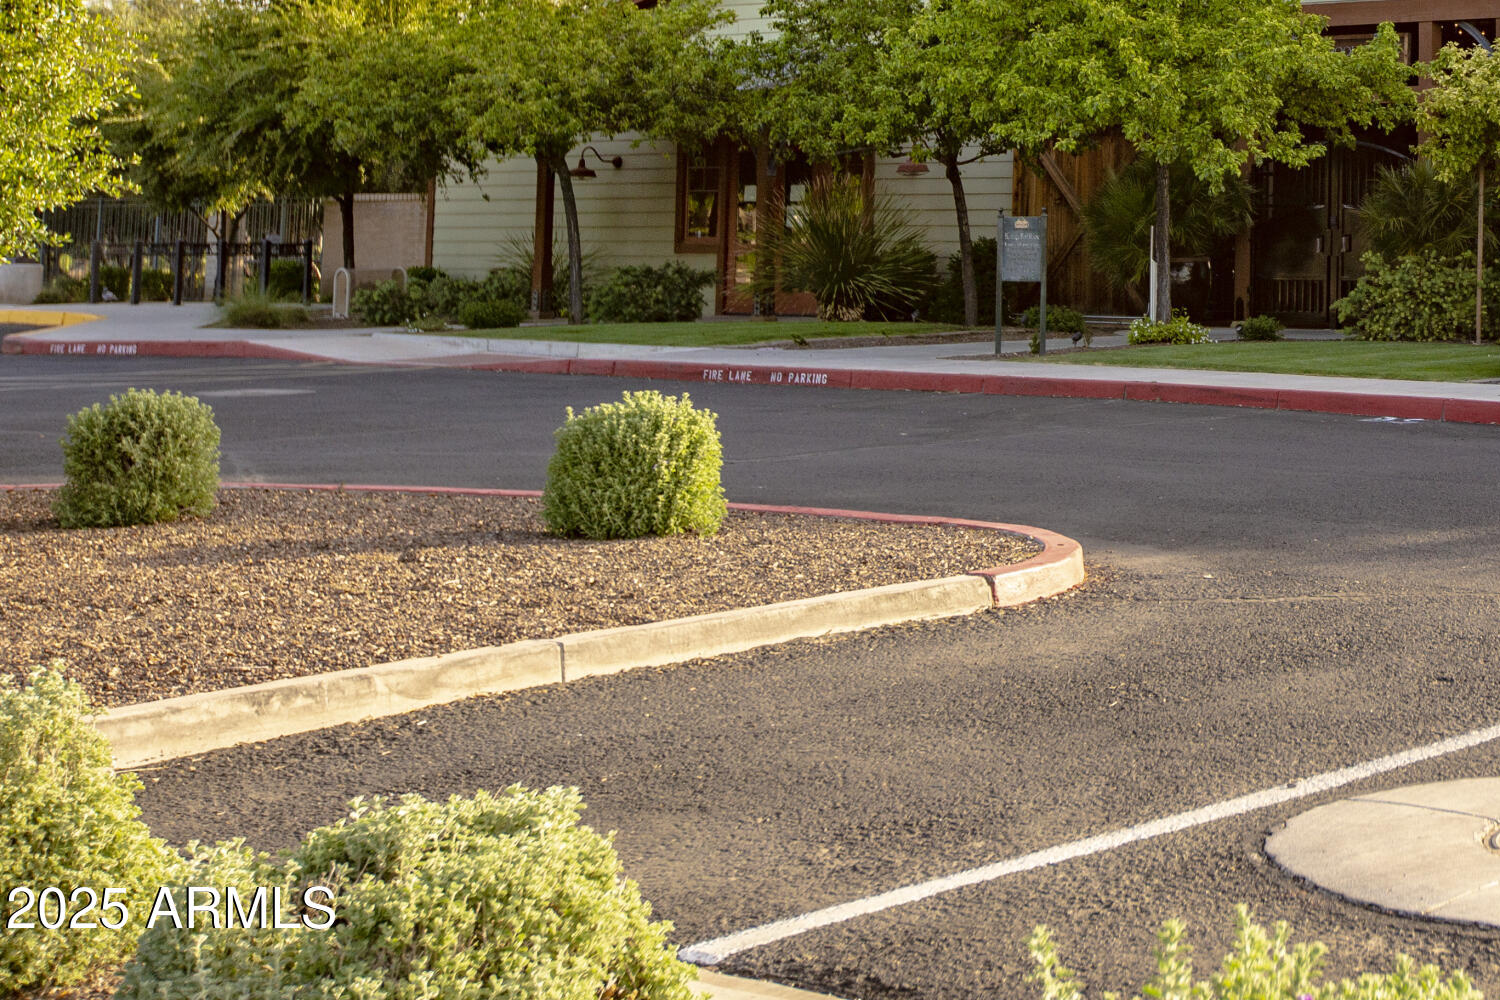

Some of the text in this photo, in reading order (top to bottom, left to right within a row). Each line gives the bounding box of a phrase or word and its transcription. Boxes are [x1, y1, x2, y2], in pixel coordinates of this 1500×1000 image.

[50, 344, 137, 355] FIRE LANE NO PARKING
[703, 369, 828, 384] FIRE LANE NO PARKING
